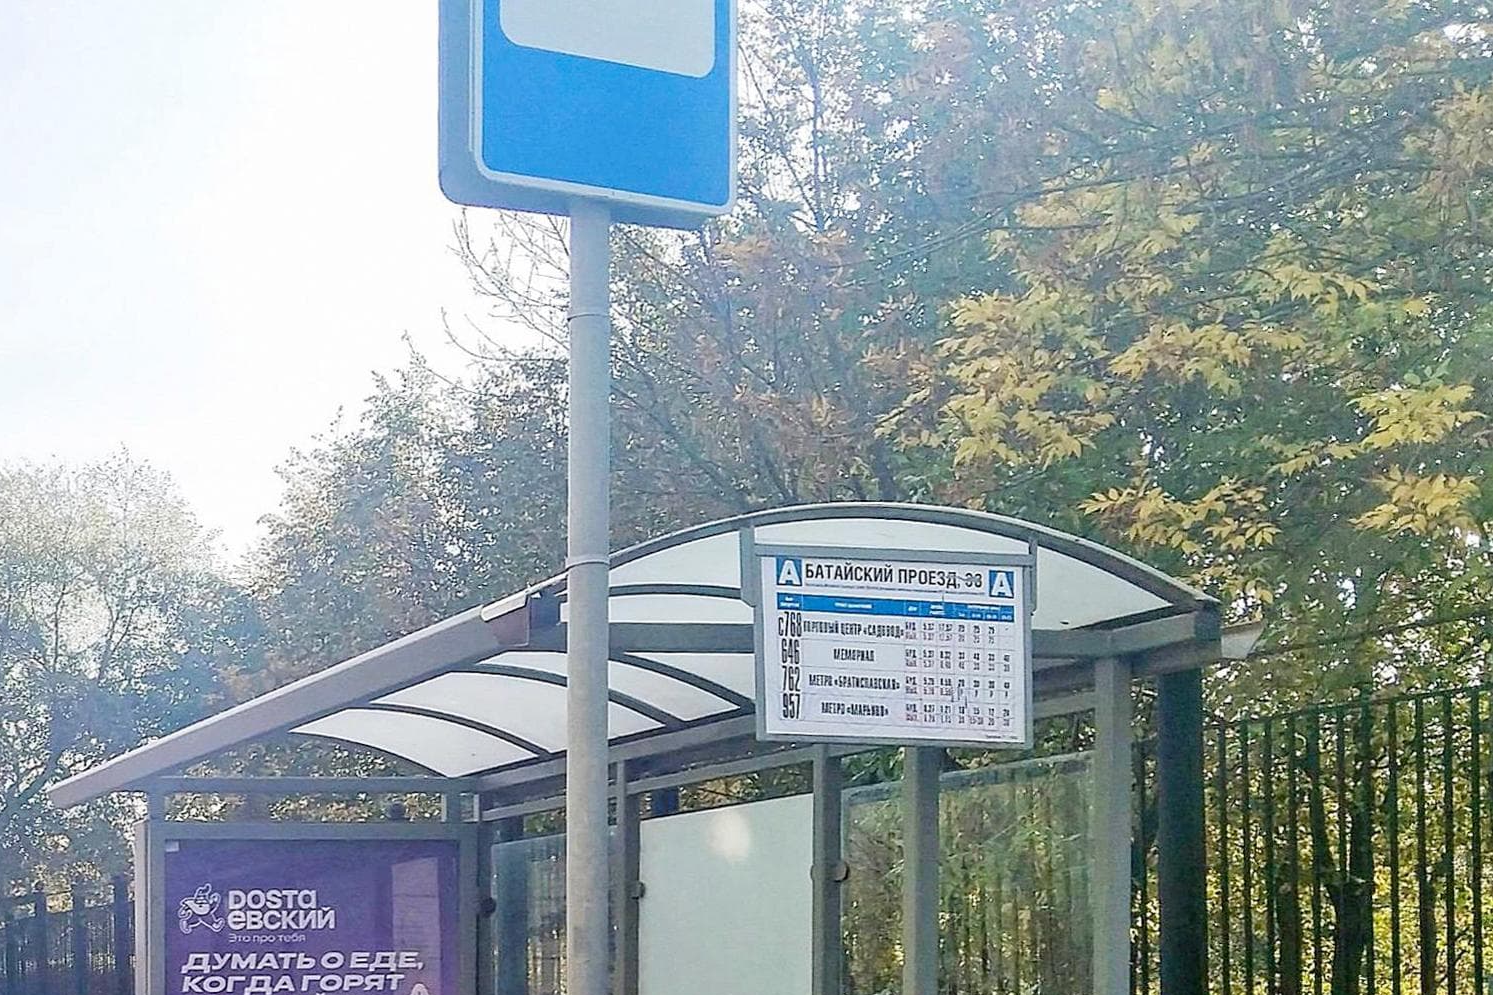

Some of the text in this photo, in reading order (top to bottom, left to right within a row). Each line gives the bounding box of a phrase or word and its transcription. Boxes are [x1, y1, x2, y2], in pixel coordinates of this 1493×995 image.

[805, 561, 894, 583] БАТАЙСКИЙ
[898, 568, 961, 589] ПРОЕЗД,
[841, 622, 861, 635] ЦЕНТР
[781, 638, 874, 664] 646 МЕМОРИАЛ
[781, 665, 800, 692] 762
[809, 674, 832, 686] МЕТРО
[782, 693, 800, 719] 957
[821, 702, 845, 714] МЕТРО
[228, 932, 306, 944] Это про тебя
[180, 951, 425, 974] ДУМАТЬ О ЕДЕ,
[181, 974, 406, 995] КОГДА ГОРЯТ
